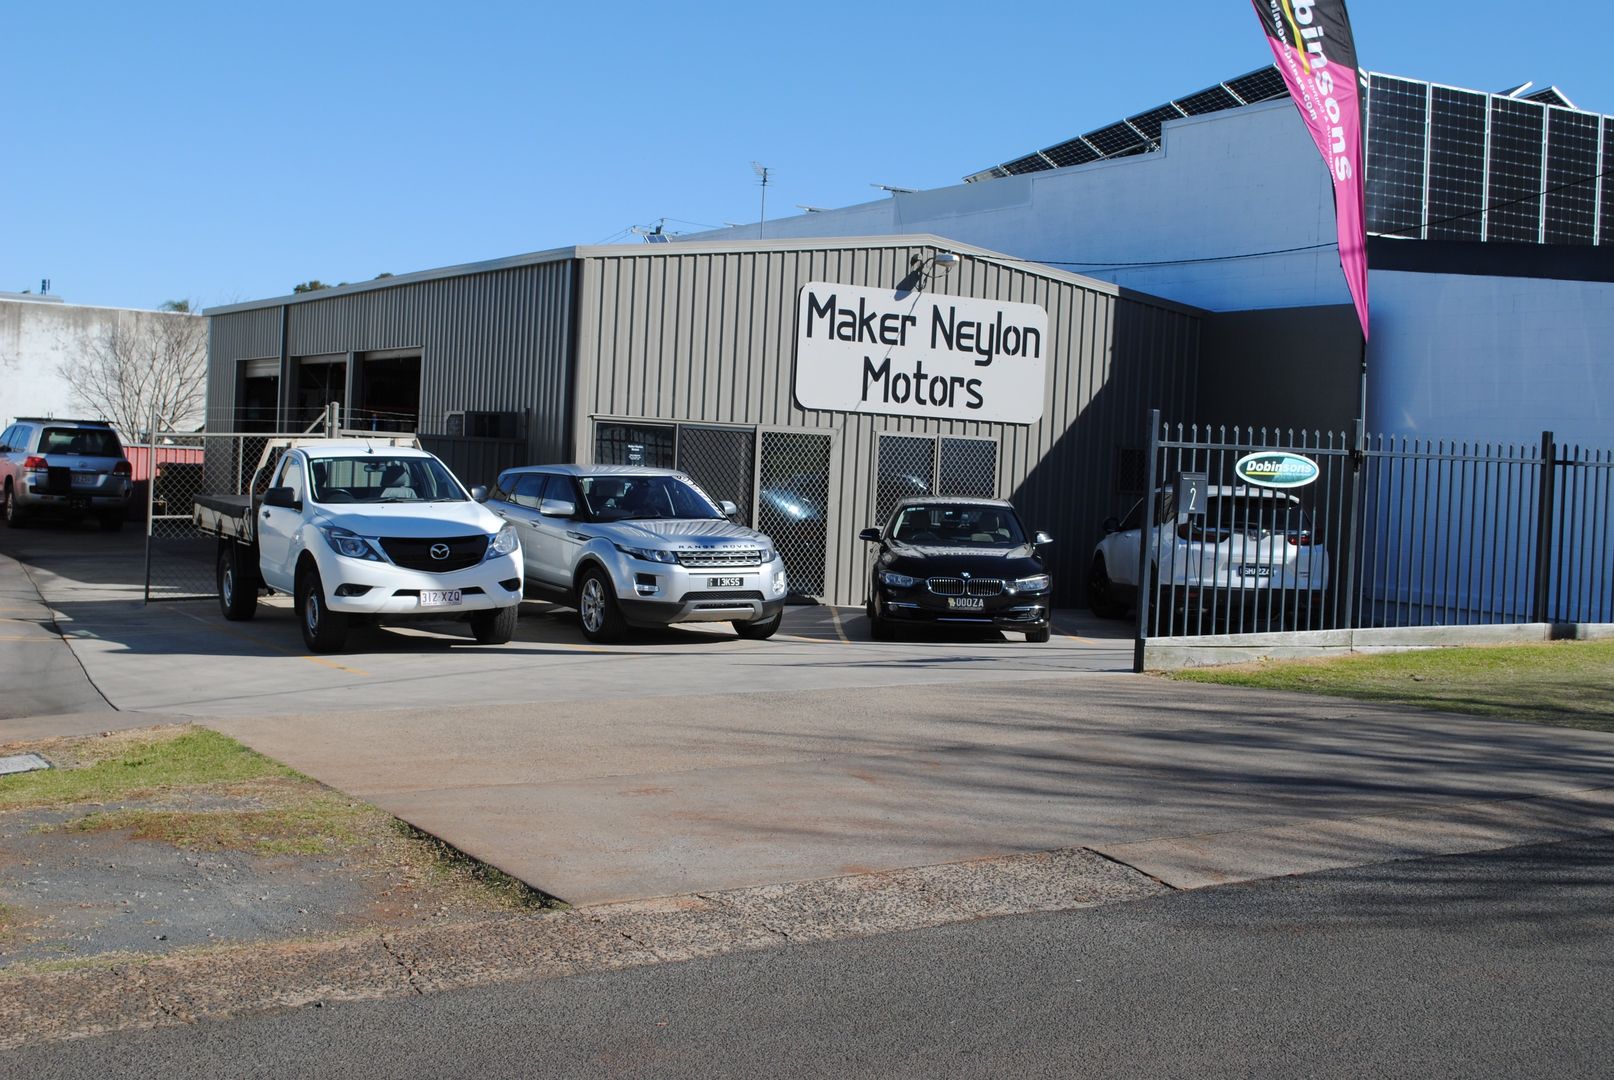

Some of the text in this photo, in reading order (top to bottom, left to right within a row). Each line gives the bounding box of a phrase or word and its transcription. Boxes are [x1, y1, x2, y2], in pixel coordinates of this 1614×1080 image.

[806, 292, 1041, 367] Maker Neylon
[861, 356, 984, 409] Motors
[1246, 460, 1312, 473] Dobinsons
[1189, 487, 1197, 510] 2
[422, 592, 460, 602] 312 XZQ
